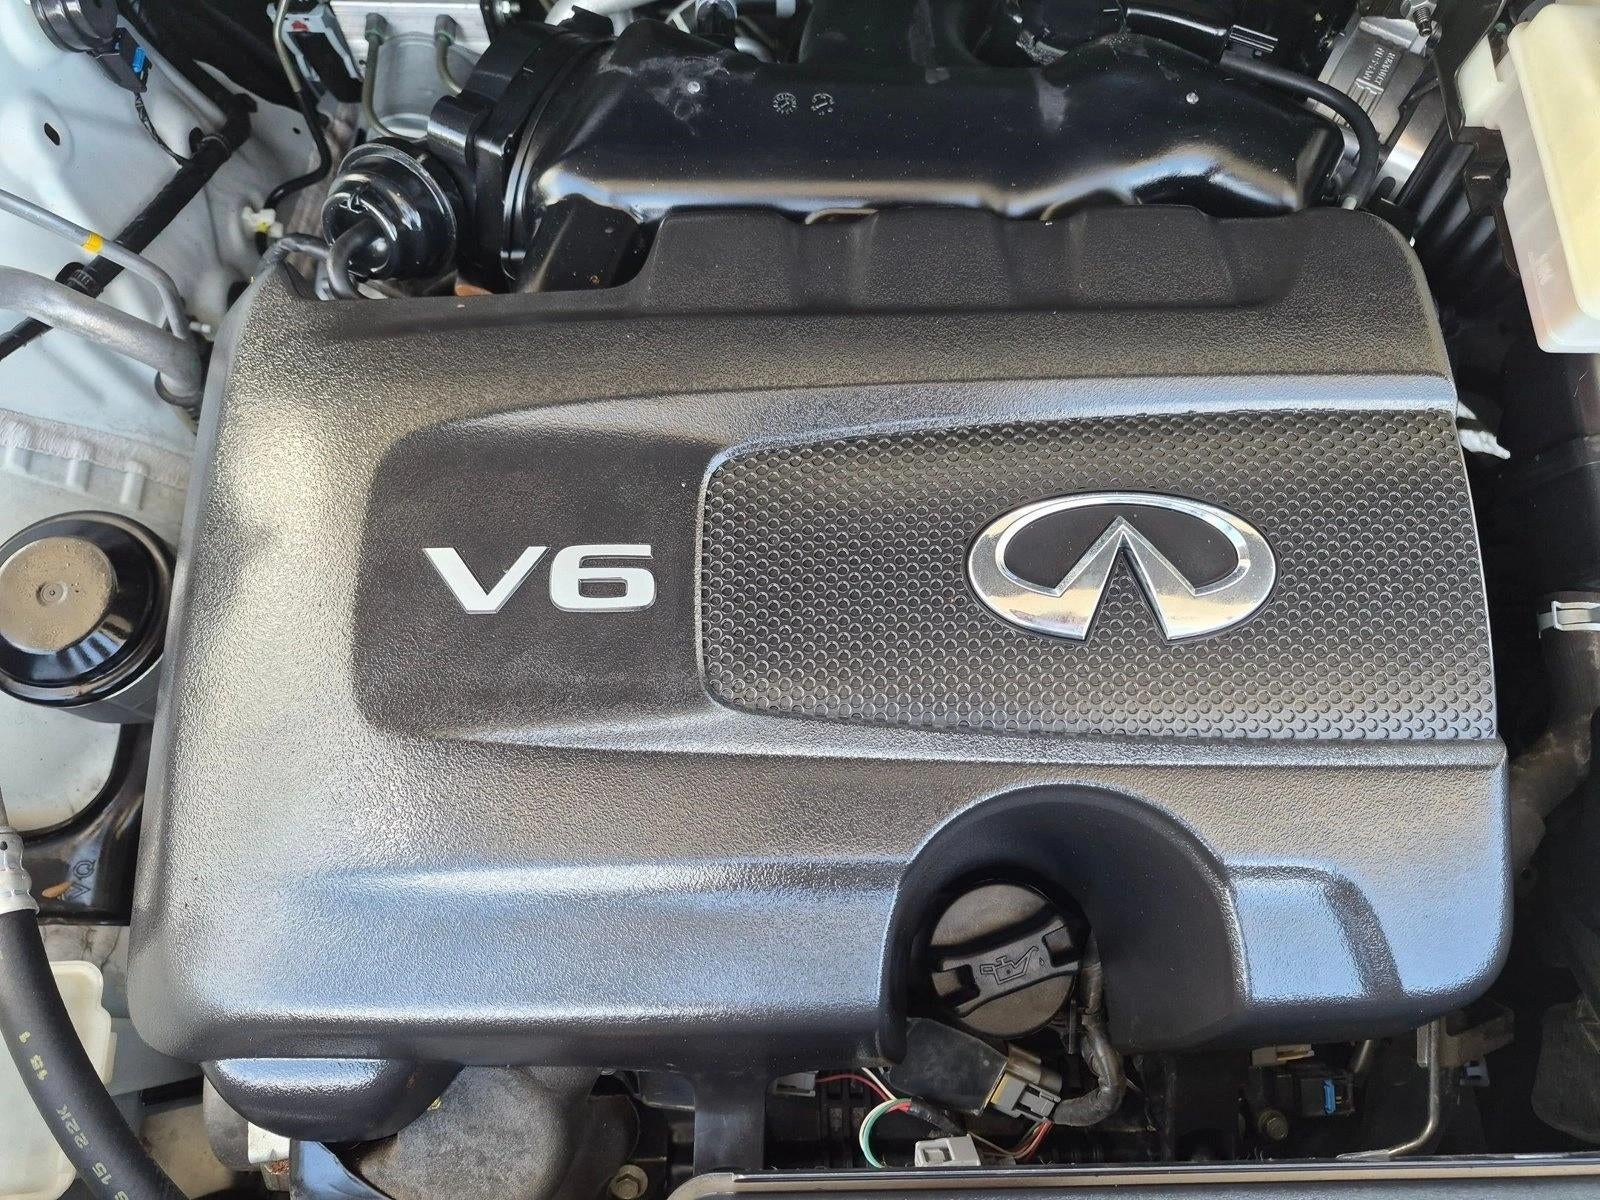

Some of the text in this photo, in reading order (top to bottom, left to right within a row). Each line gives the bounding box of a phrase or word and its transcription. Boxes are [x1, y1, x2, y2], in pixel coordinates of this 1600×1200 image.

[1363, 47, 1385, 81] NISSAN
[422, 544, 656, 614] V6
[56, 1104, 89, 1149] 22K
[92, 1162, 112, 1185] 15
